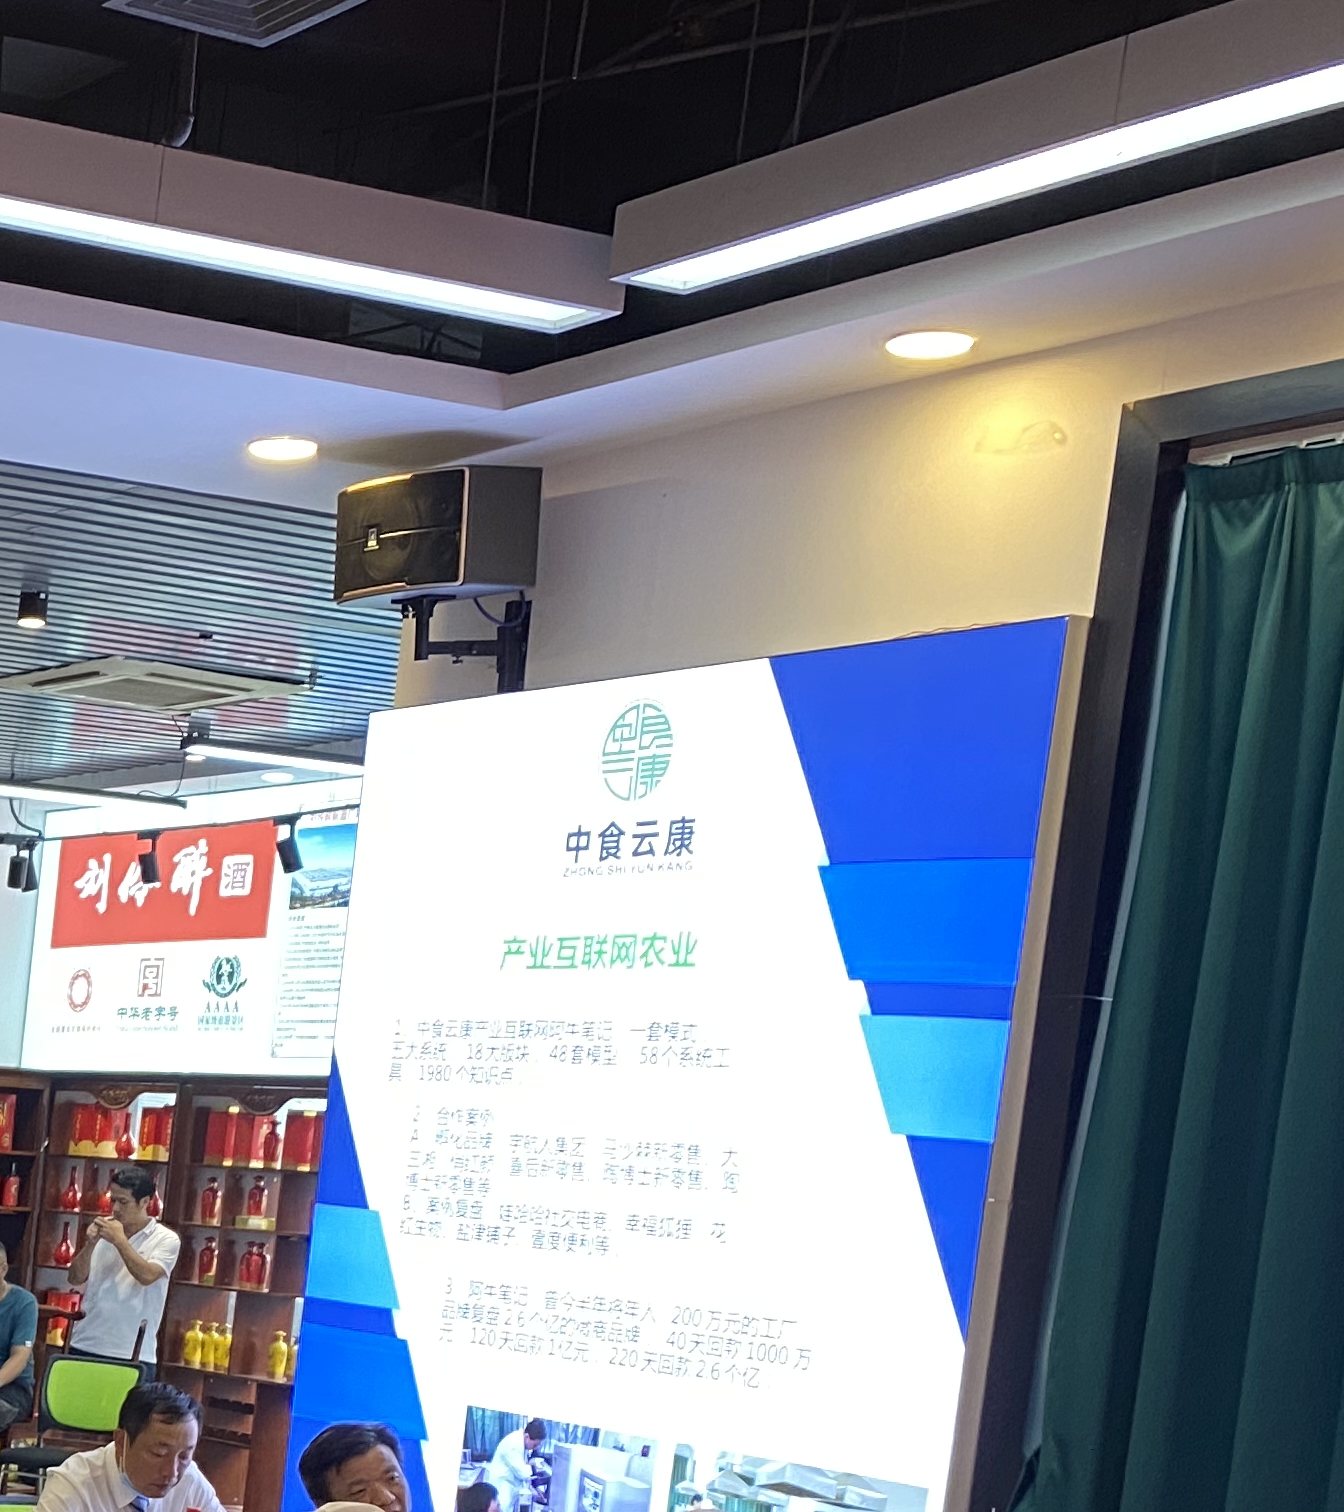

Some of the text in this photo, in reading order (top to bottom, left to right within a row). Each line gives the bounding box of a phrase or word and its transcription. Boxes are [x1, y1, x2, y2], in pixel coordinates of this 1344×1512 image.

[564, 815, 697, 864] 中食云康
[562, 859, 694, 878] ZHONG SHI YUN KANG
[499, 931, 699, 971] 产业互联网农业
